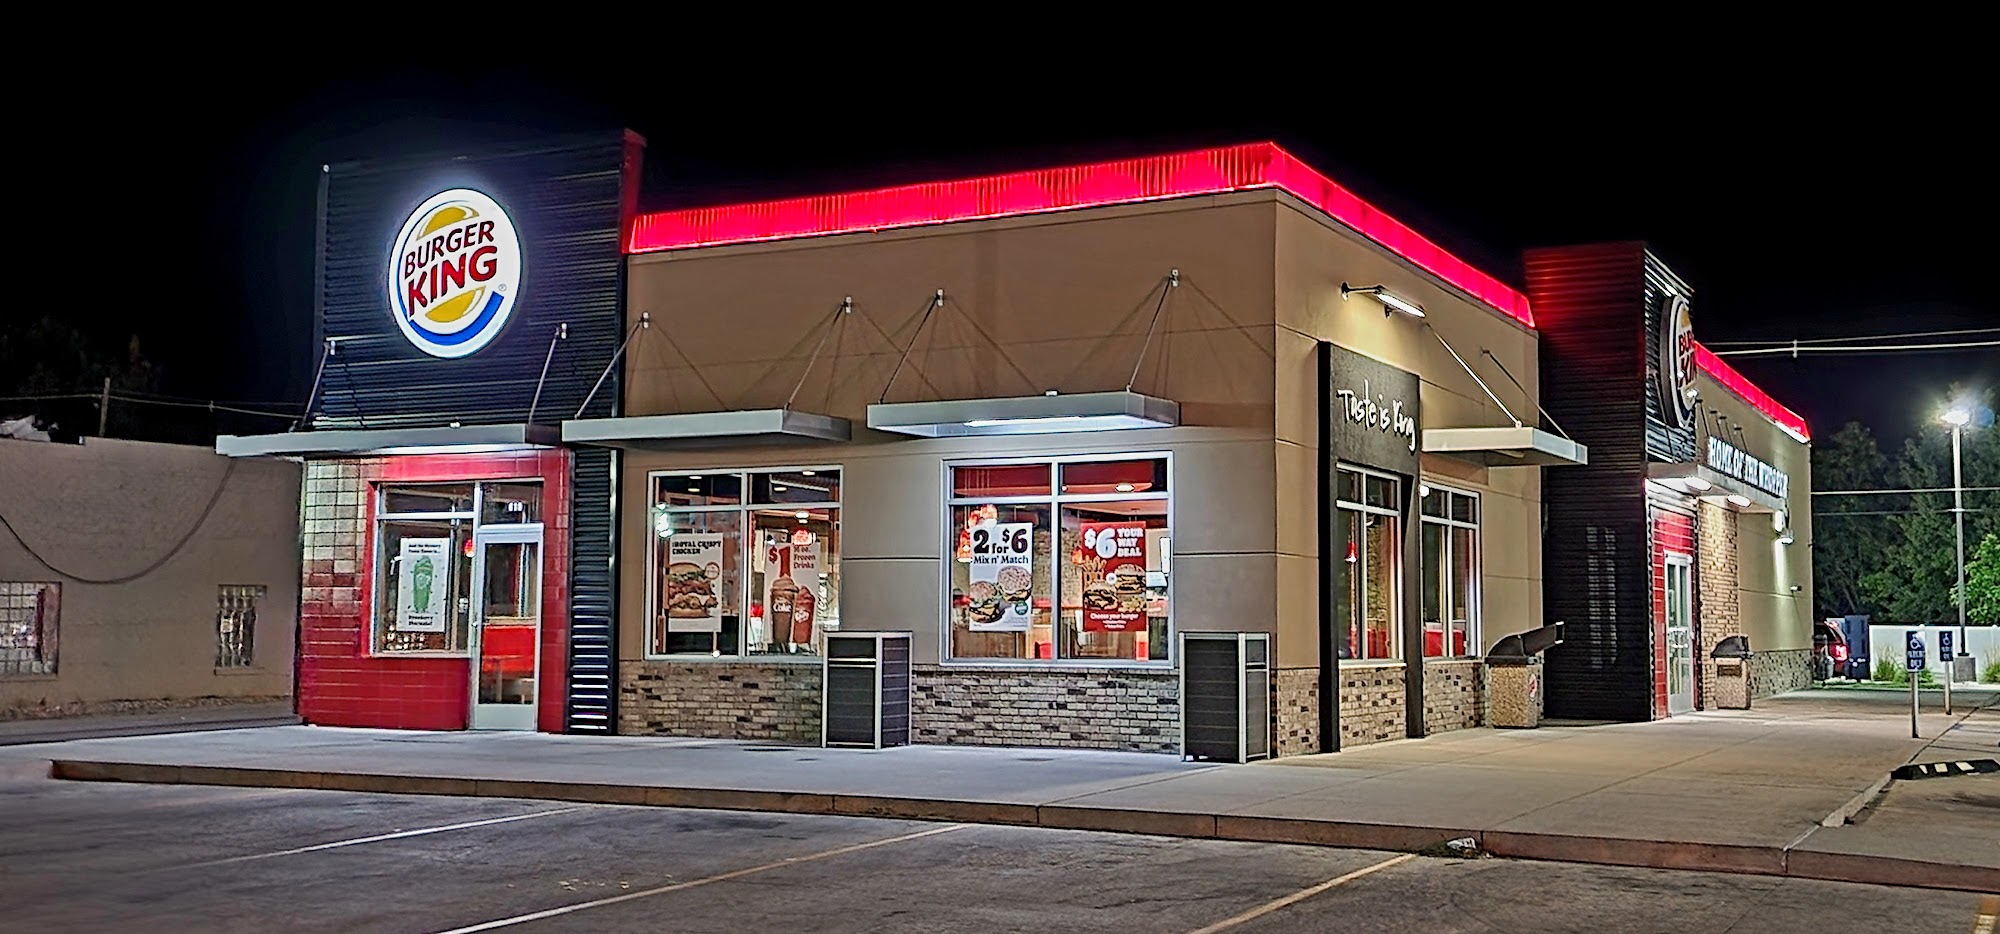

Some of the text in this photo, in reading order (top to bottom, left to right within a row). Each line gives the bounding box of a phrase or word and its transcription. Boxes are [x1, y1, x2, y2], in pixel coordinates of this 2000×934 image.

[404, 220, 495, 280] BURGER
[408, 245, 498, 318] KING
[1336, 379, 1417, 453] Taste is King
[1707, 436, 1733, 475] HOME
[1733, 448, 1744, 480] OF
[1744, 453, 1758, 486] THE
[973, 529, 990, 554] 2
[992, 543, 1009, 554] for
[1117, 528, 1144, 538] YOUR
[697, 541, 722, 549] CRISPY
[1084, 528, 1117, 559] $6
[1117, 537, 1138, 548] WAY
[973, 555, 990, 564] Mix
[1000, 555, 1029, 564] Match
[1117, 547, 1142, 558] DEAL
[772, 602, 793, 613] Coke
